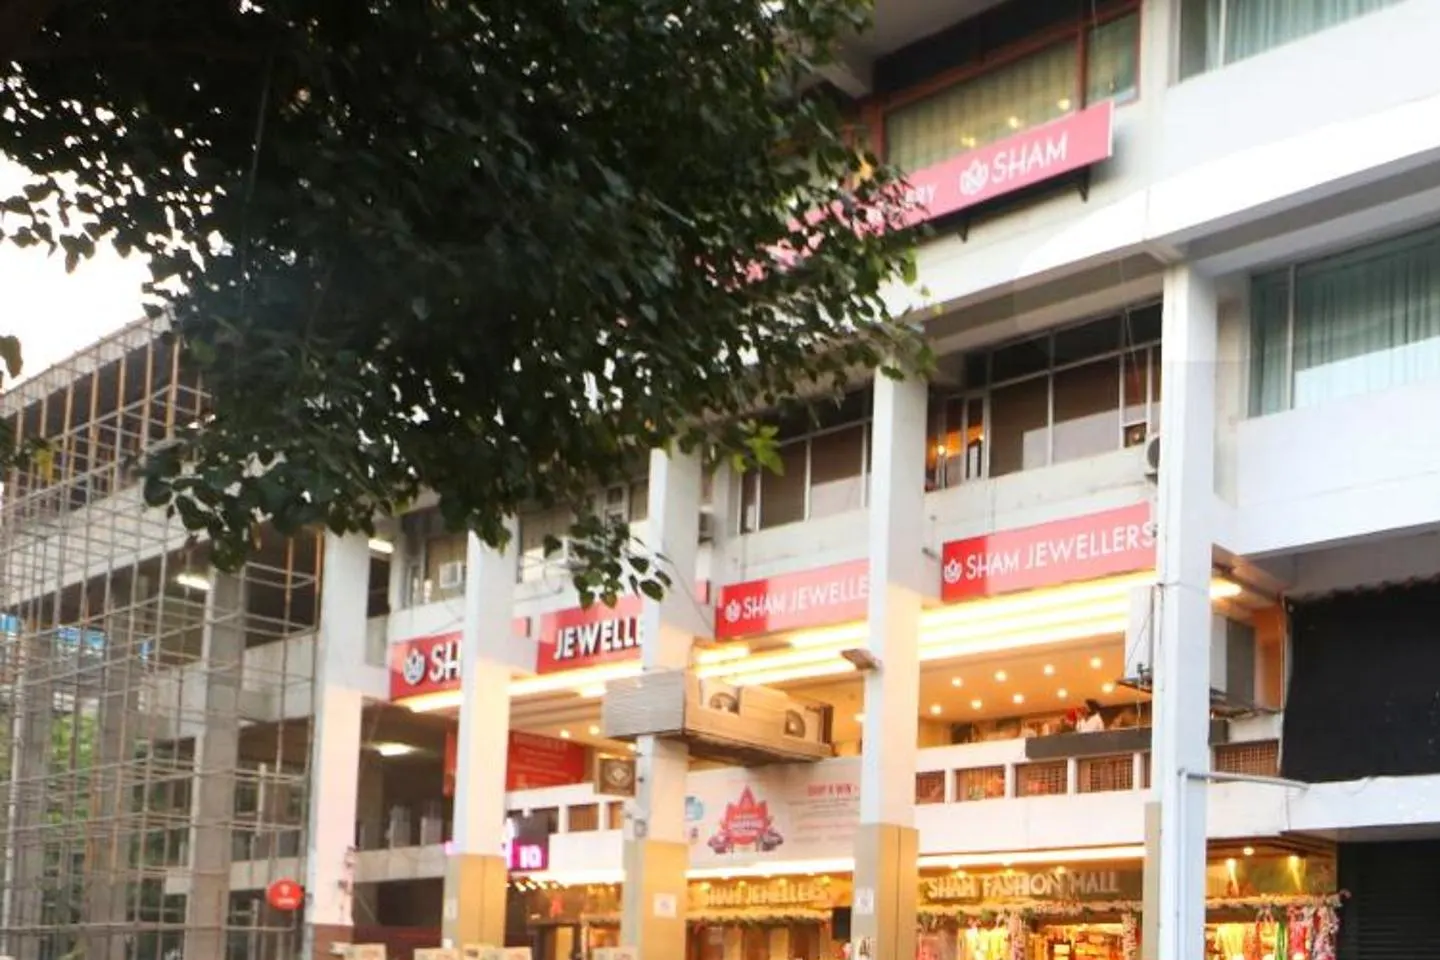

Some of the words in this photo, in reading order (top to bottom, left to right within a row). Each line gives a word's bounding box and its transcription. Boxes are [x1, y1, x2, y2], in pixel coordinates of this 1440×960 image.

[991, 132, 1069, 184] SHAM
[966, 549, 1020, 580] SHAM
[1025, 521, 1157, 570] JEWELLERS
[743, 592, 787, 621] SHAM
[790, 575, 871, 614] JEWELLE
[429, 640, 462, 682] SH
[553, 616, 644, 661] JEWELLE
[928, 876, 979, 899] SHAM
[982, 873, 1062, 897] FASHION
[1069, 871, 1120, 894] MALL
